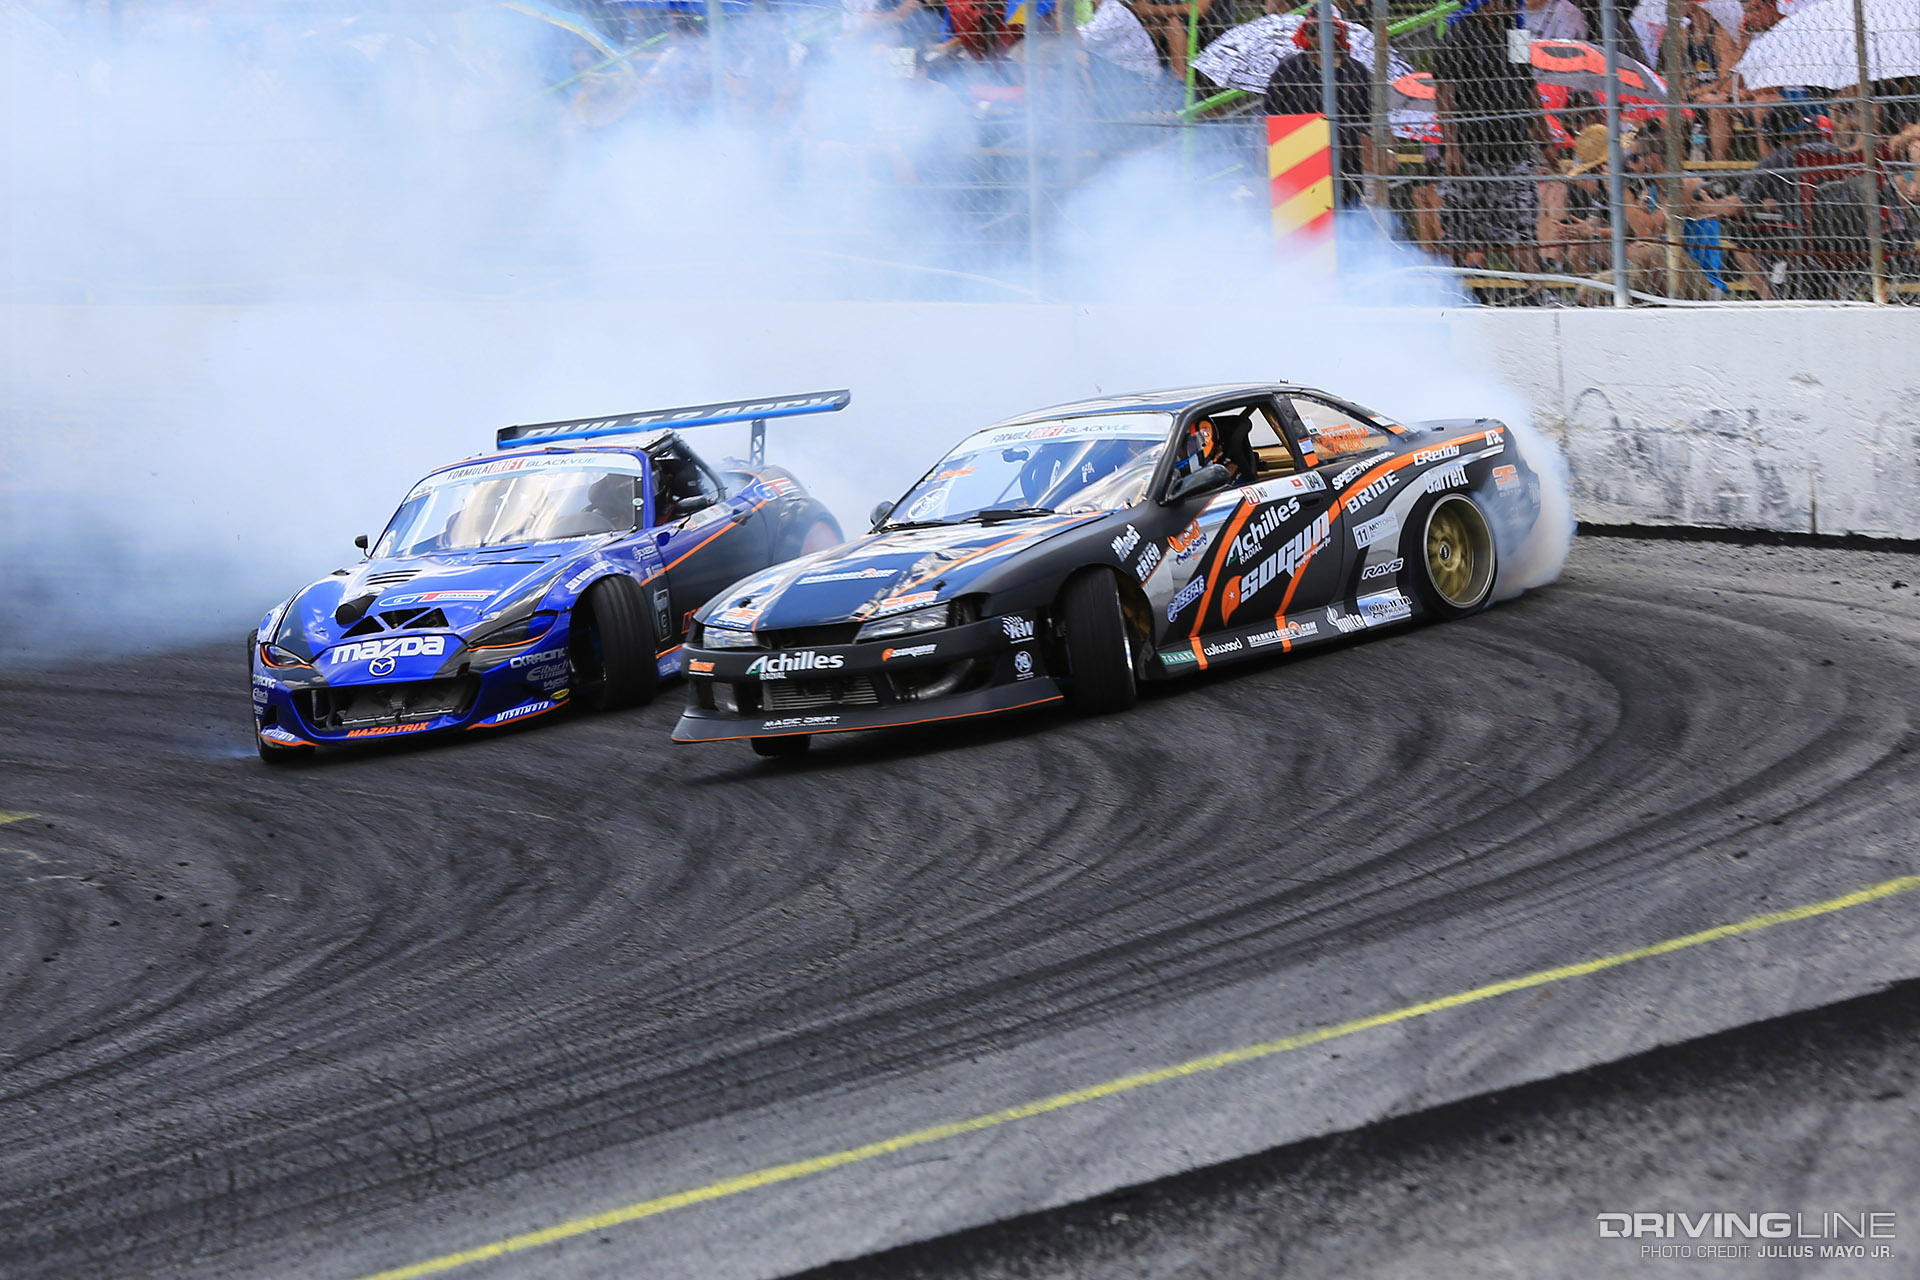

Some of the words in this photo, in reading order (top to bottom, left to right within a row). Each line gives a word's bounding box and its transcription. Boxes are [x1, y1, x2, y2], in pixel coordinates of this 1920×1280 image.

[447, 464, 490, 481] FORMULA
[487, 458, 525, 474] DRIFT
[525, 456, 596, 468] BLACKVUE
[1305, 474, 1321, 489] 84
[1345, 469, 1400, 514] BRIDE
[1226, 496, 1301, 567] Achilles
[1369, 515, 1395, 532] MOTORS
[1357, 528, 1369, 543] 11
[1239, 543, 1263, 565] RADIAL
[1362, 557, 1404, 580] RAYS
[745, 650, 844, 675] Achilles
[760, 671, 787, 681] RADIAL
[346, 721, 430, 738] MAZDATRIX
